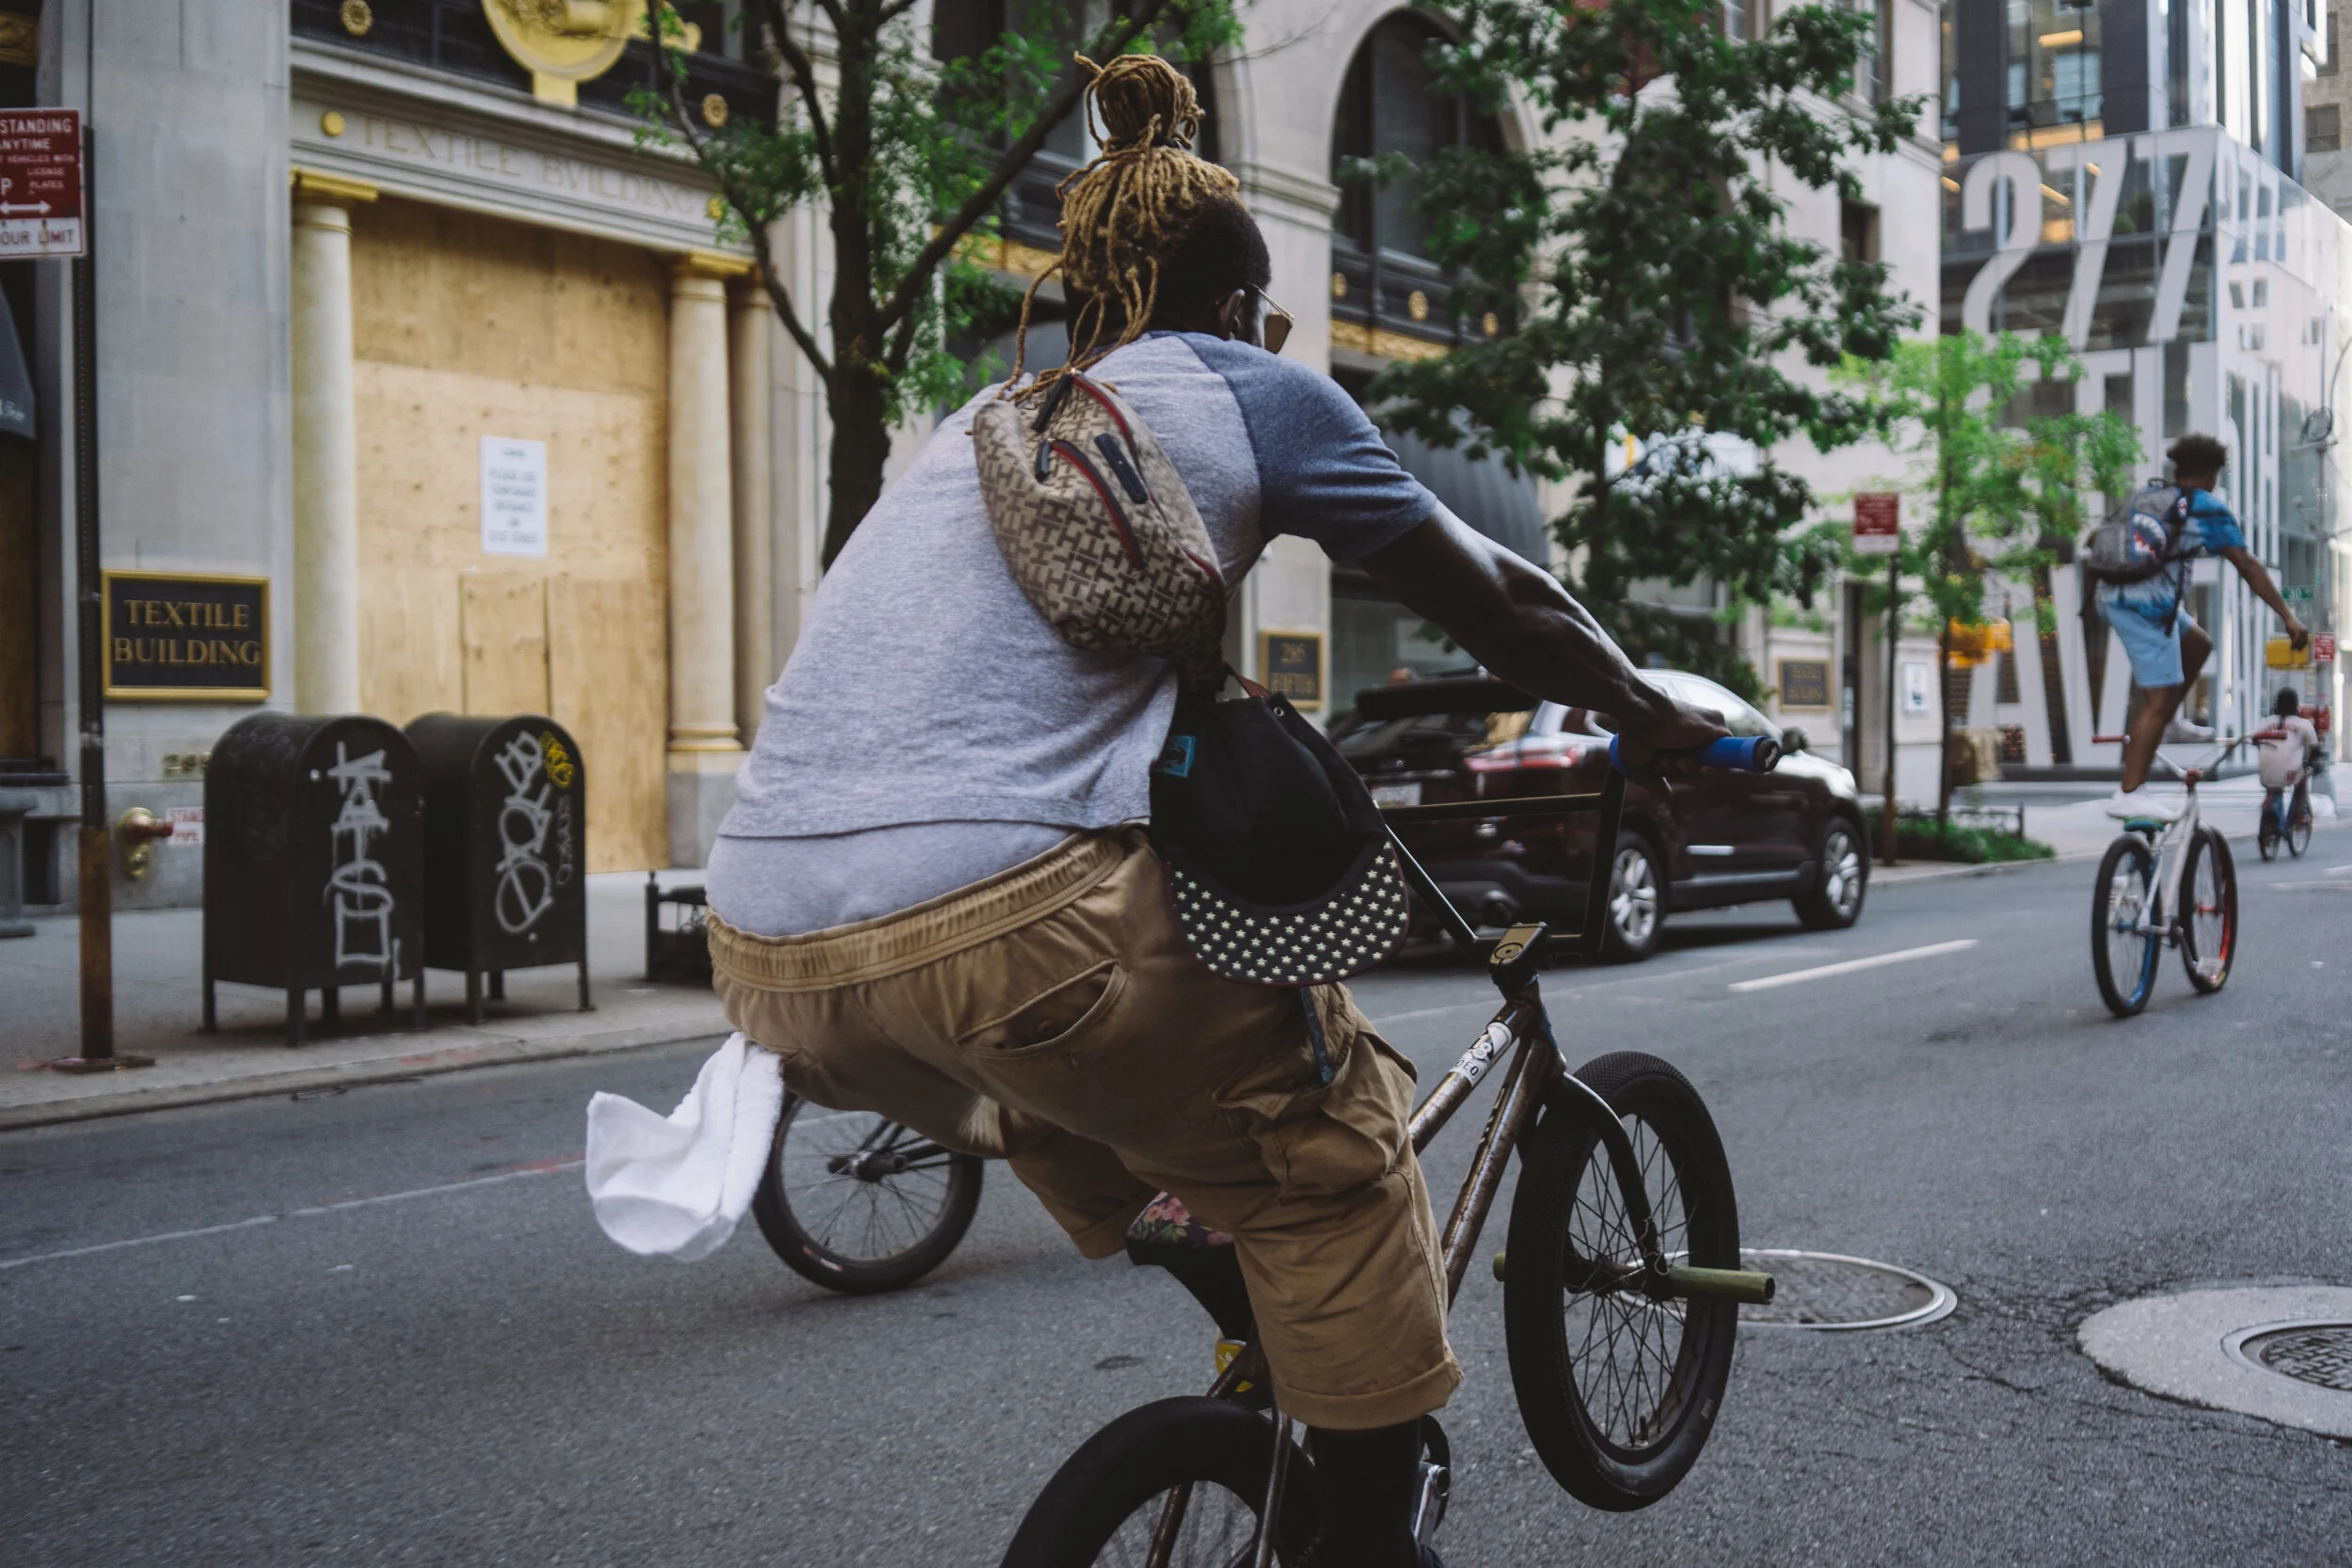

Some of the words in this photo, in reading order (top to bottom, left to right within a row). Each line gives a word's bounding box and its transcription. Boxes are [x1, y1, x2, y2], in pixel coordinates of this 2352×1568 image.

[0, 119, 73, 134] STANDING
[358, 115, 521, 177] TEXTILE
[26, 166, 65, 176] LICENSE
[1963, 137, 2217, 353] 277
[123, 598, 250, 627] TEXTILE
[112, 637, 262, 666] BUILDING
